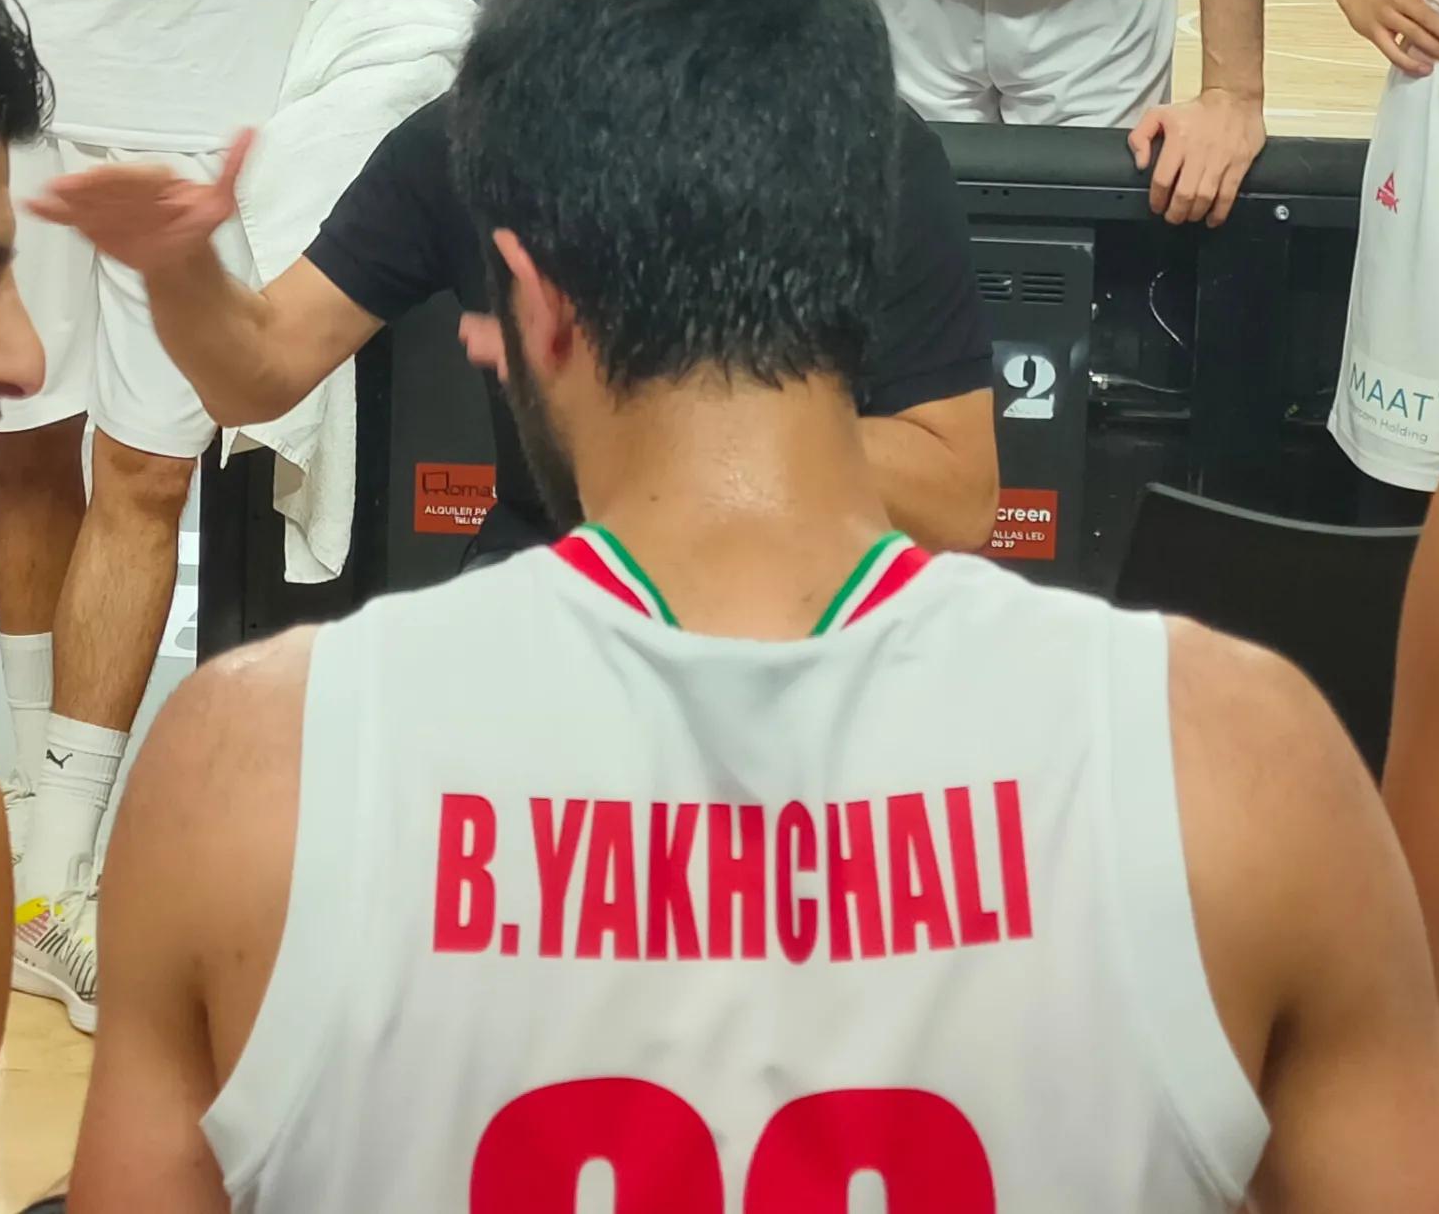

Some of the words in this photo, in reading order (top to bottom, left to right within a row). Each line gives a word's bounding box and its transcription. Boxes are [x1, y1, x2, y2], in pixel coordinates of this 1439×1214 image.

[1002, 354, 1057, 420] 2
[1349, 361, 1435, 423] MAAT
[1380, 418, 1429, 445] Holding
[424, 505, 472, 517] ALQUILER
[474, 506, 487, 516] PA
[995, 506, 1052, 523] creen
[992, 529, 1023, 541] ALLAS
[1025, 531, 1045, 542] LED
[432, 779, 1034, 966] B.YAKHCHALI
